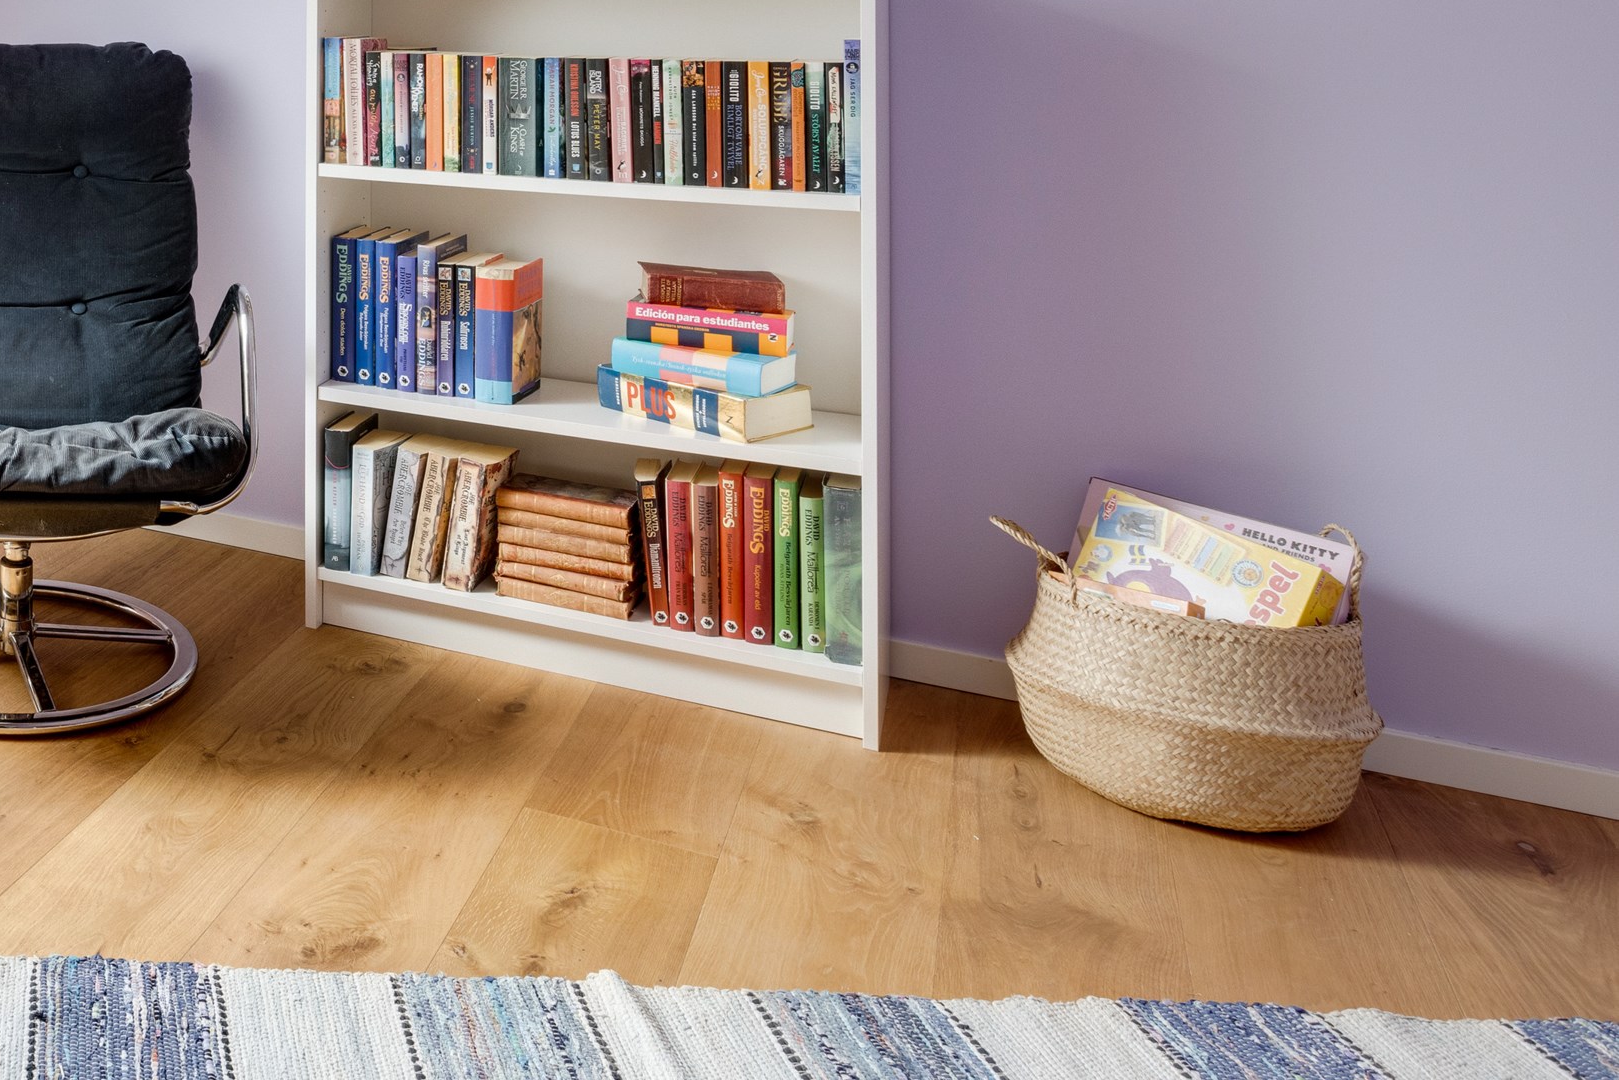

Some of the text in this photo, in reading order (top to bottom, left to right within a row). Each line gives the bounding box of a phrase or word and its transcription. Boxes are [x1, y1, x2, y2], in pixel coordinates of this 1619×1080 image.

[349, 43, 359, 76] MORTAL
[570, 64, 579, 89] KRISTINA
[351, 78, 360, 106] FOLLIES
[416, 63, 424, 95] RAMONA
[510, 60, 520, 100] MARTIN
[729, 74, 739, 102] GIOLITO
[772, 71, 788, 122] GREBE
[510, 127, 520, 153] KINGS
[519, 129, 527, 150] CLASH
[571, 122, 580, 158] LOTUS BLUES
[757, 104, 767, 170] SOLUPPGÅNG
[810, 81, 820, 173] GIOLITO STÖRST AV ALLT
[727, 142, 735, 170] TVIVEL
[336, 244, 348, 303] EDDINGS
[359, 254, 369, 301] EDDINGS
[379, 256, 389, 303] EDDINGS
[439, 282, 448, 316] EDDINGS
[458, 282, 468, 317] EDDINGS
[460, 321, 469, 350] Safirrosen
[635, 306, 770, 331] Edición para estudiantes
[418, 338, 426, 386] EDDINGS
[626, 381, 676, 420] PLUS
[358, 481, 366, 505] HAND
[394, 458, 408, 514] ABERCROMBIE
[405, 483, 413, 496] JOE
[422, 459, 438, 513] ABERCROMBIE
[458, 470, 472, 522] ABERCROMBIE
[722, 479, 735, 528] EDDINGS
[357, 511, 366, 528] GOD
[423, 517, 431, 527] The
[644, 501, 657, 538] EDDINGS
[648, 508, 658, 531] DAVID
[672, 491, 680, 527] EDDINGS
[698, 495, 706, 531] EDDINGS
[749, 486, 765, 554] EDDINGS
[779, 488, 791, 537] EDDINGS
[420, 530, 429, 546] Blade
[805, 509, 813, 546] EDDINGS
[1242, 528, 1339, 560] HELLO KITTY
[674, 532, 686, 573] Mallorea
[699, 536, 712, 577] Mallorea
[1282, 549, 1315, 562] FRIENDS
[726, 566, 734, 604] Besvärjaren
[754, 564, 762, 589] Kupoler
[807, 551, 819, 593] Mallorea
[784, 581, 792, 625] Besvärjaren
